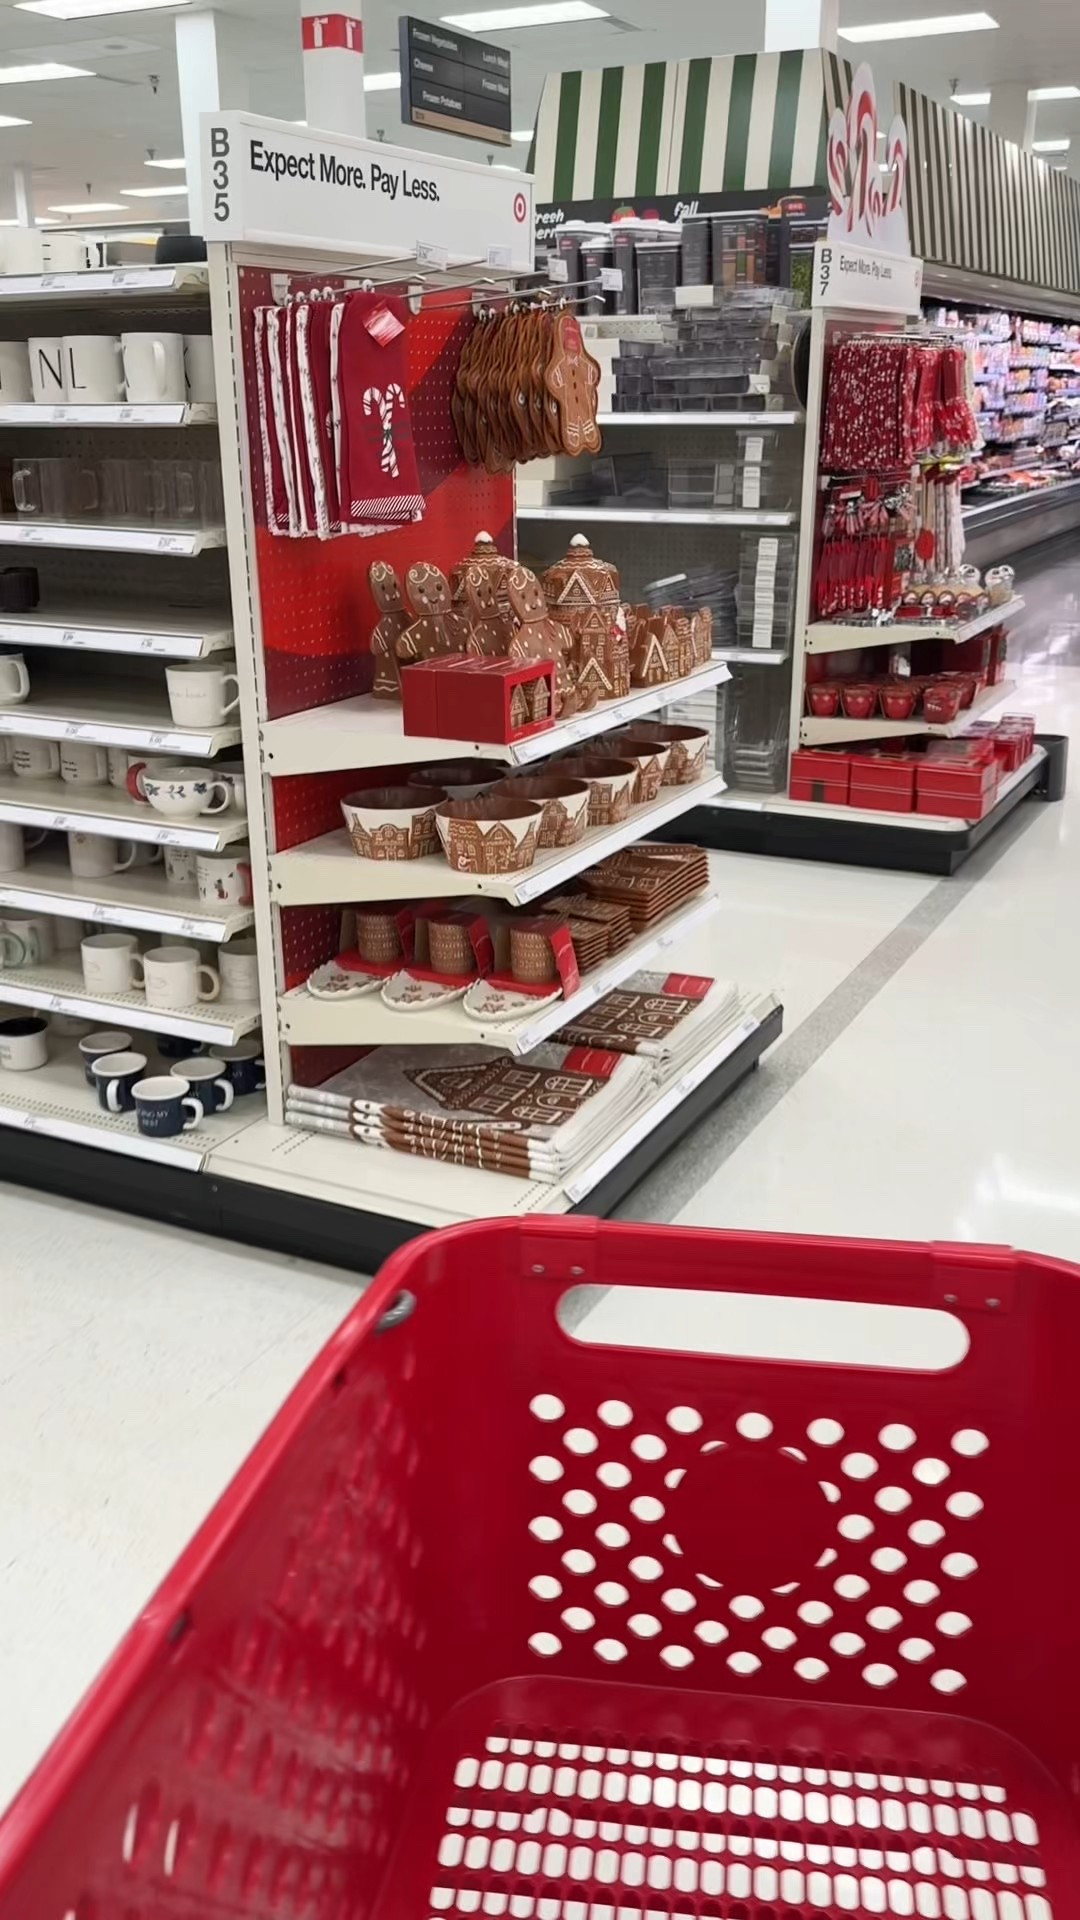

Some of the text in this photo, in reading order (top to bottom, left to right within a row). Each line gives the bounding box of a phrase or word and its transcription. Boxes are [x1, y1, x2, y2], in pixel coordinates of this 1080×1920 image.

[250, 139, 440, 202] Expect More. Pay Less.
[535, 208, 565, 224] resh
[839, 255, 858, 277] Expect
